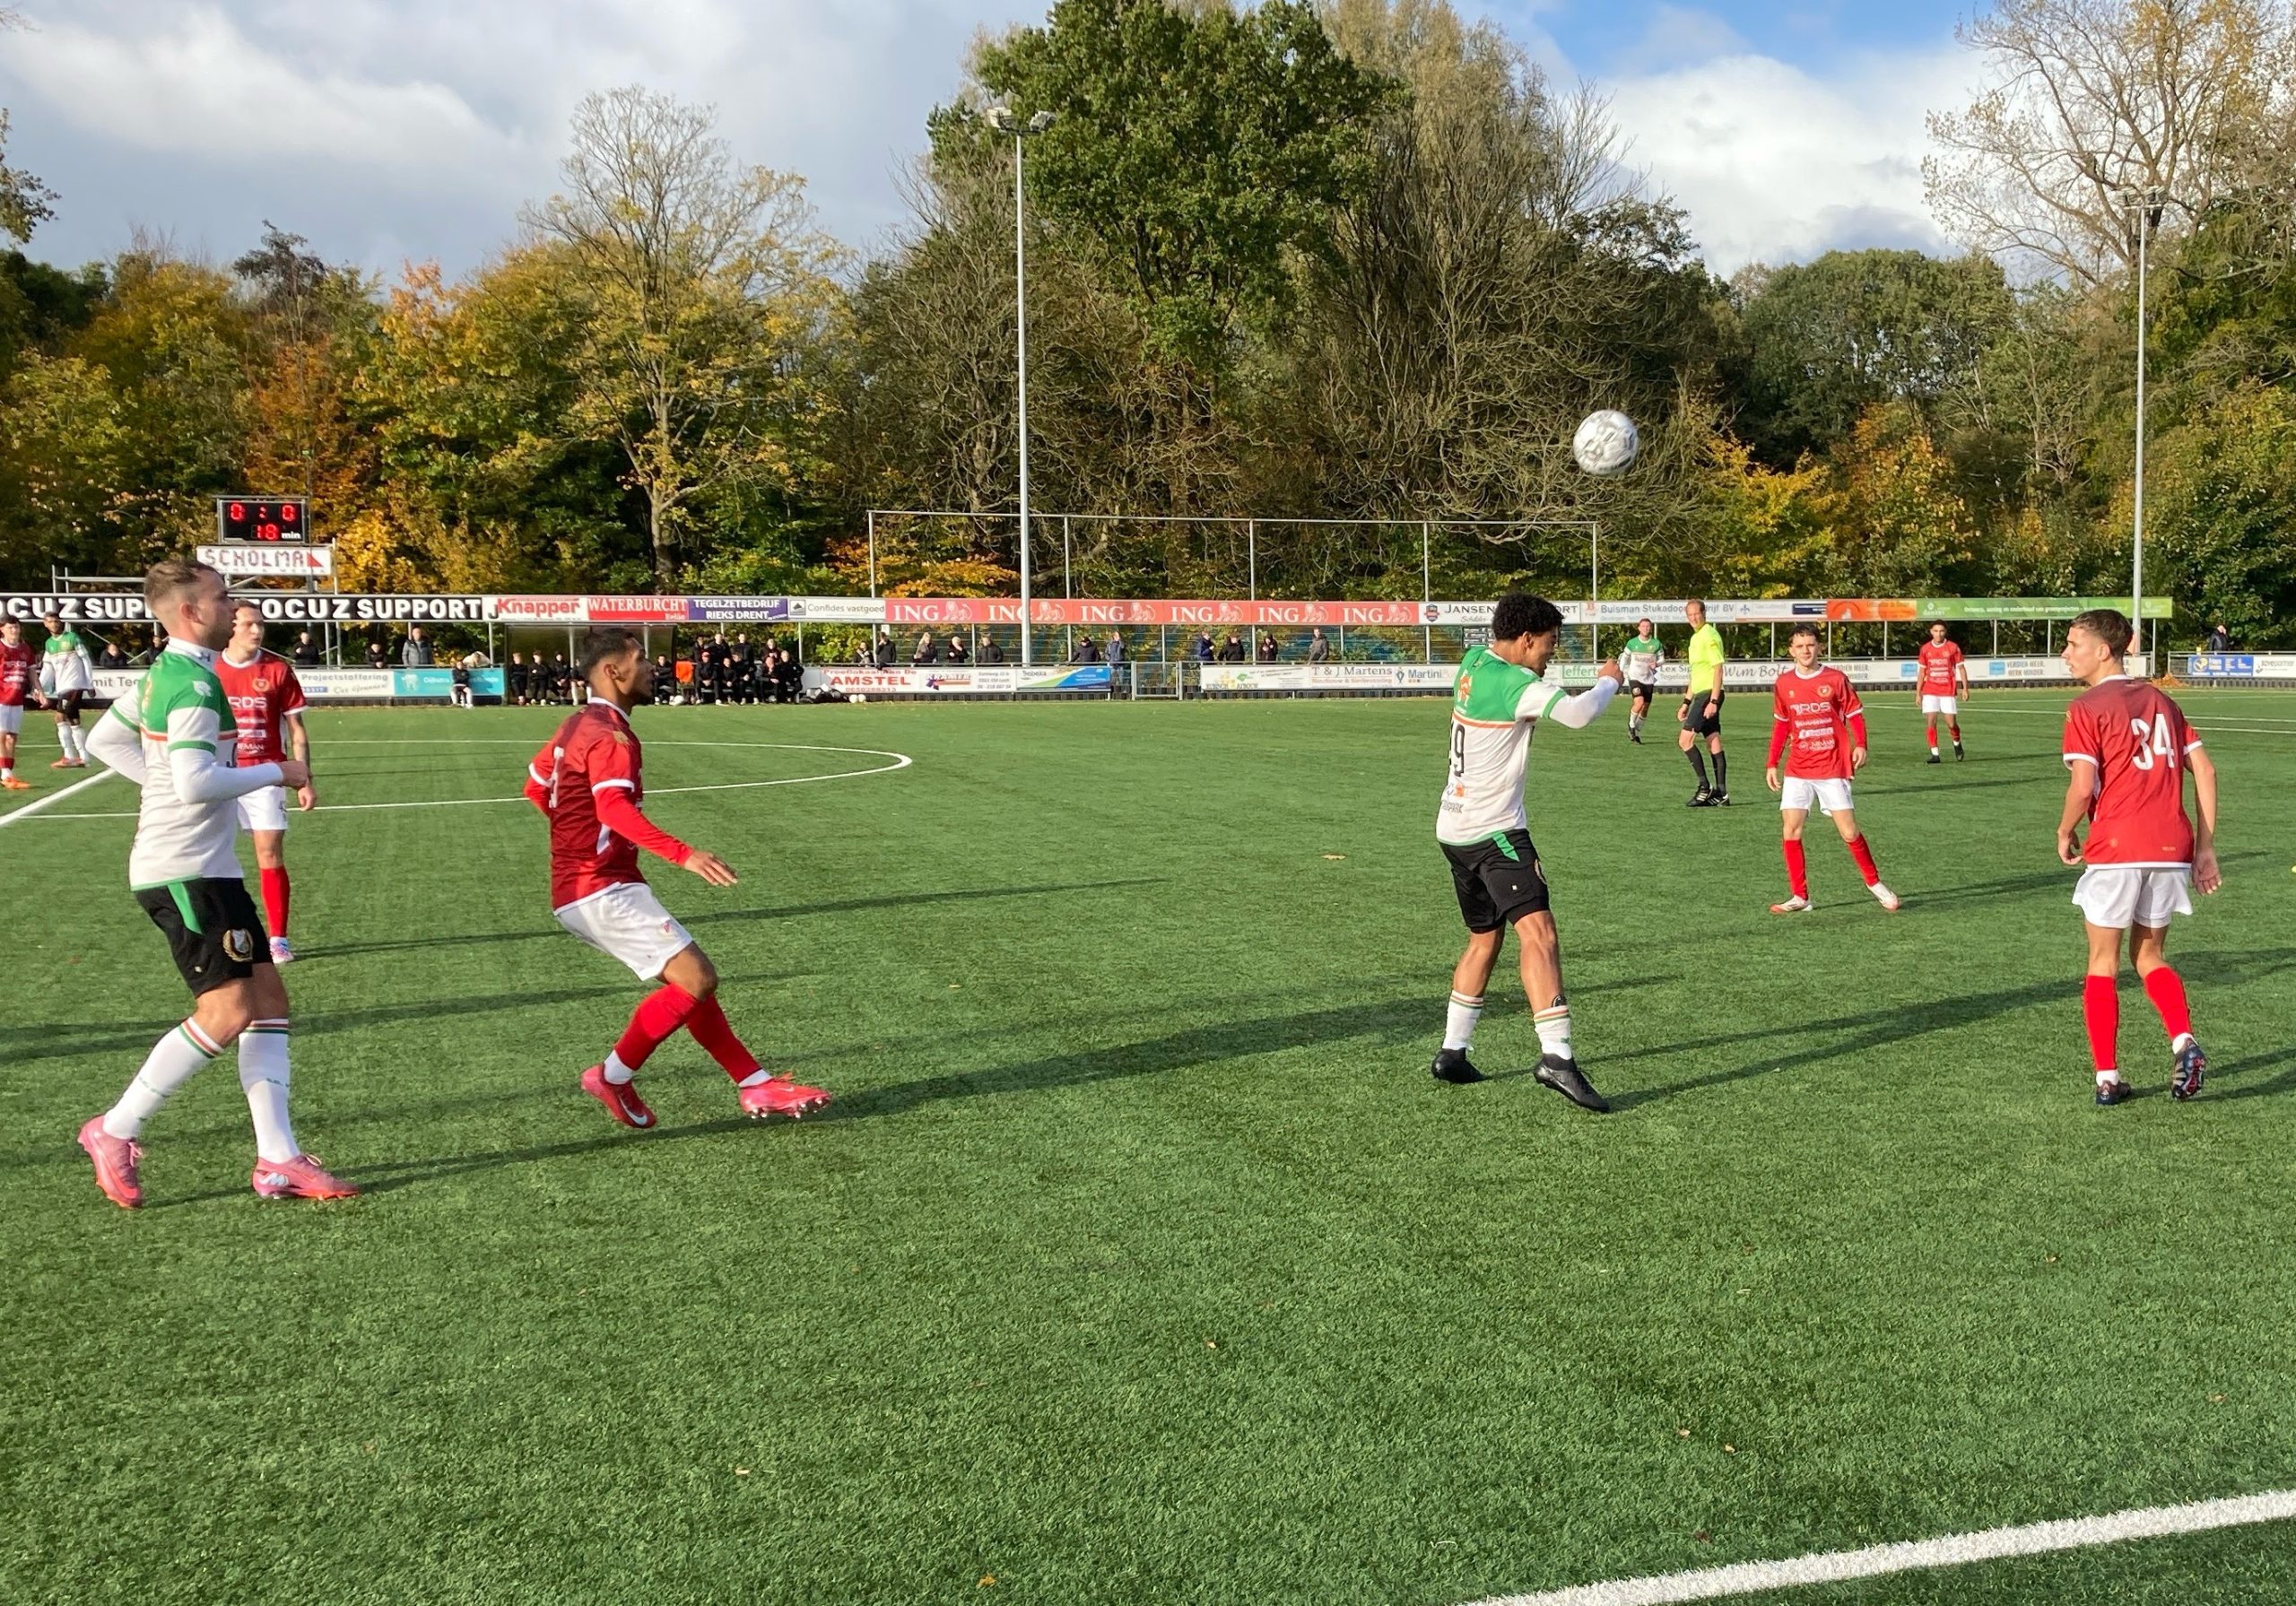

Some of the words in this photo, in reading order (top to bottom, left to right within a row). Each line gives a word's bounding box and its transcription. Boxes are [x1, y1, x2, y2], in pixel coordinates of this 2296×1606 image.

[281, 531, 302, 539] min
[204, 549, 303, 568] SCHOLMA
[243, 598, 351, 619] OCUZ
[357, 598, 482, 620] SUPPORT
[587, 598, 687, 612] WATERBURCHT
[694, 599, 780, 609] TEGELZETBEDRIJF
[808, 603, 844, 612] Confides
[847, 604, 884, 614] vastgoed
[1601, 605, 1640, 613] Buisman
[1723, 604, 1735, 612] BV
[706, 611, 734, 620] RIEKS
[735, 611, 769, 620] DRENT
[893, 605, 939, 621] ING
[1081, 605, 1124, 621] ING
[1171, 606, 1213, 622] ING
[1258, 607, 1299, 622] ING
[1343, 607, 1383, 622] ING
[1312, 667, 1319, 675] T
[1324, 667, 1332, 675] &
[1335, 667, 1339, 677] J
[1344, 666, 1392, 675] Martens
[1723, 665, 1756, 676] Wim
[1759, 664, 1788, 676] Bolt
[830, 676, 911, 685] AMSTEL
[1449, 720, 1465, 777] 9
[2130, 713, 2175, 771] 34
